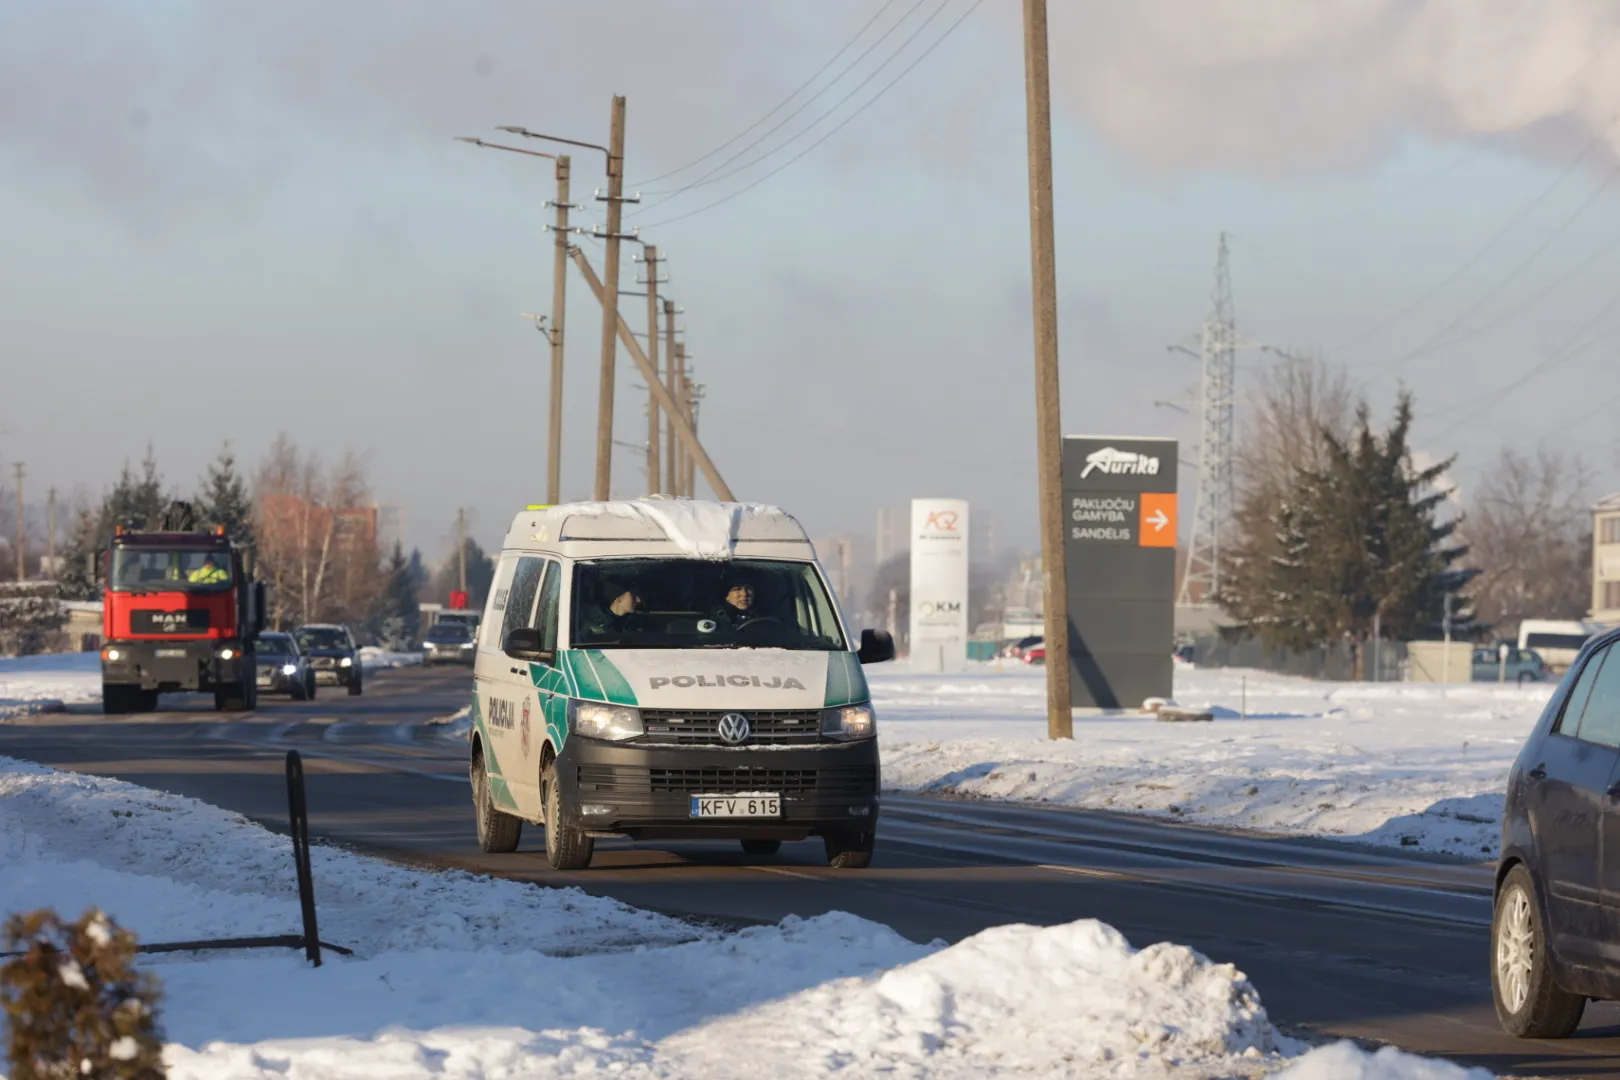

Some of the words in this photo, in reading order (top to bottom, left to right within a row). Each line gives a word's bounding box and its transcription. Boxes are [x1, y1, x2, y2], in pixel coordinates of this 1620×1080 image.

[1080, 446, 1160, 479] Aurika
[1072, 510, 1125, 522] GAMYBA
[152, 614, 188, 624] MAN
[648, 674, 807, 691] POLICIJA
[488, 696, 515, 731] POLICIJA
[701, 800, 737, 815] KFV
[748, 799, 778, 815] 615
